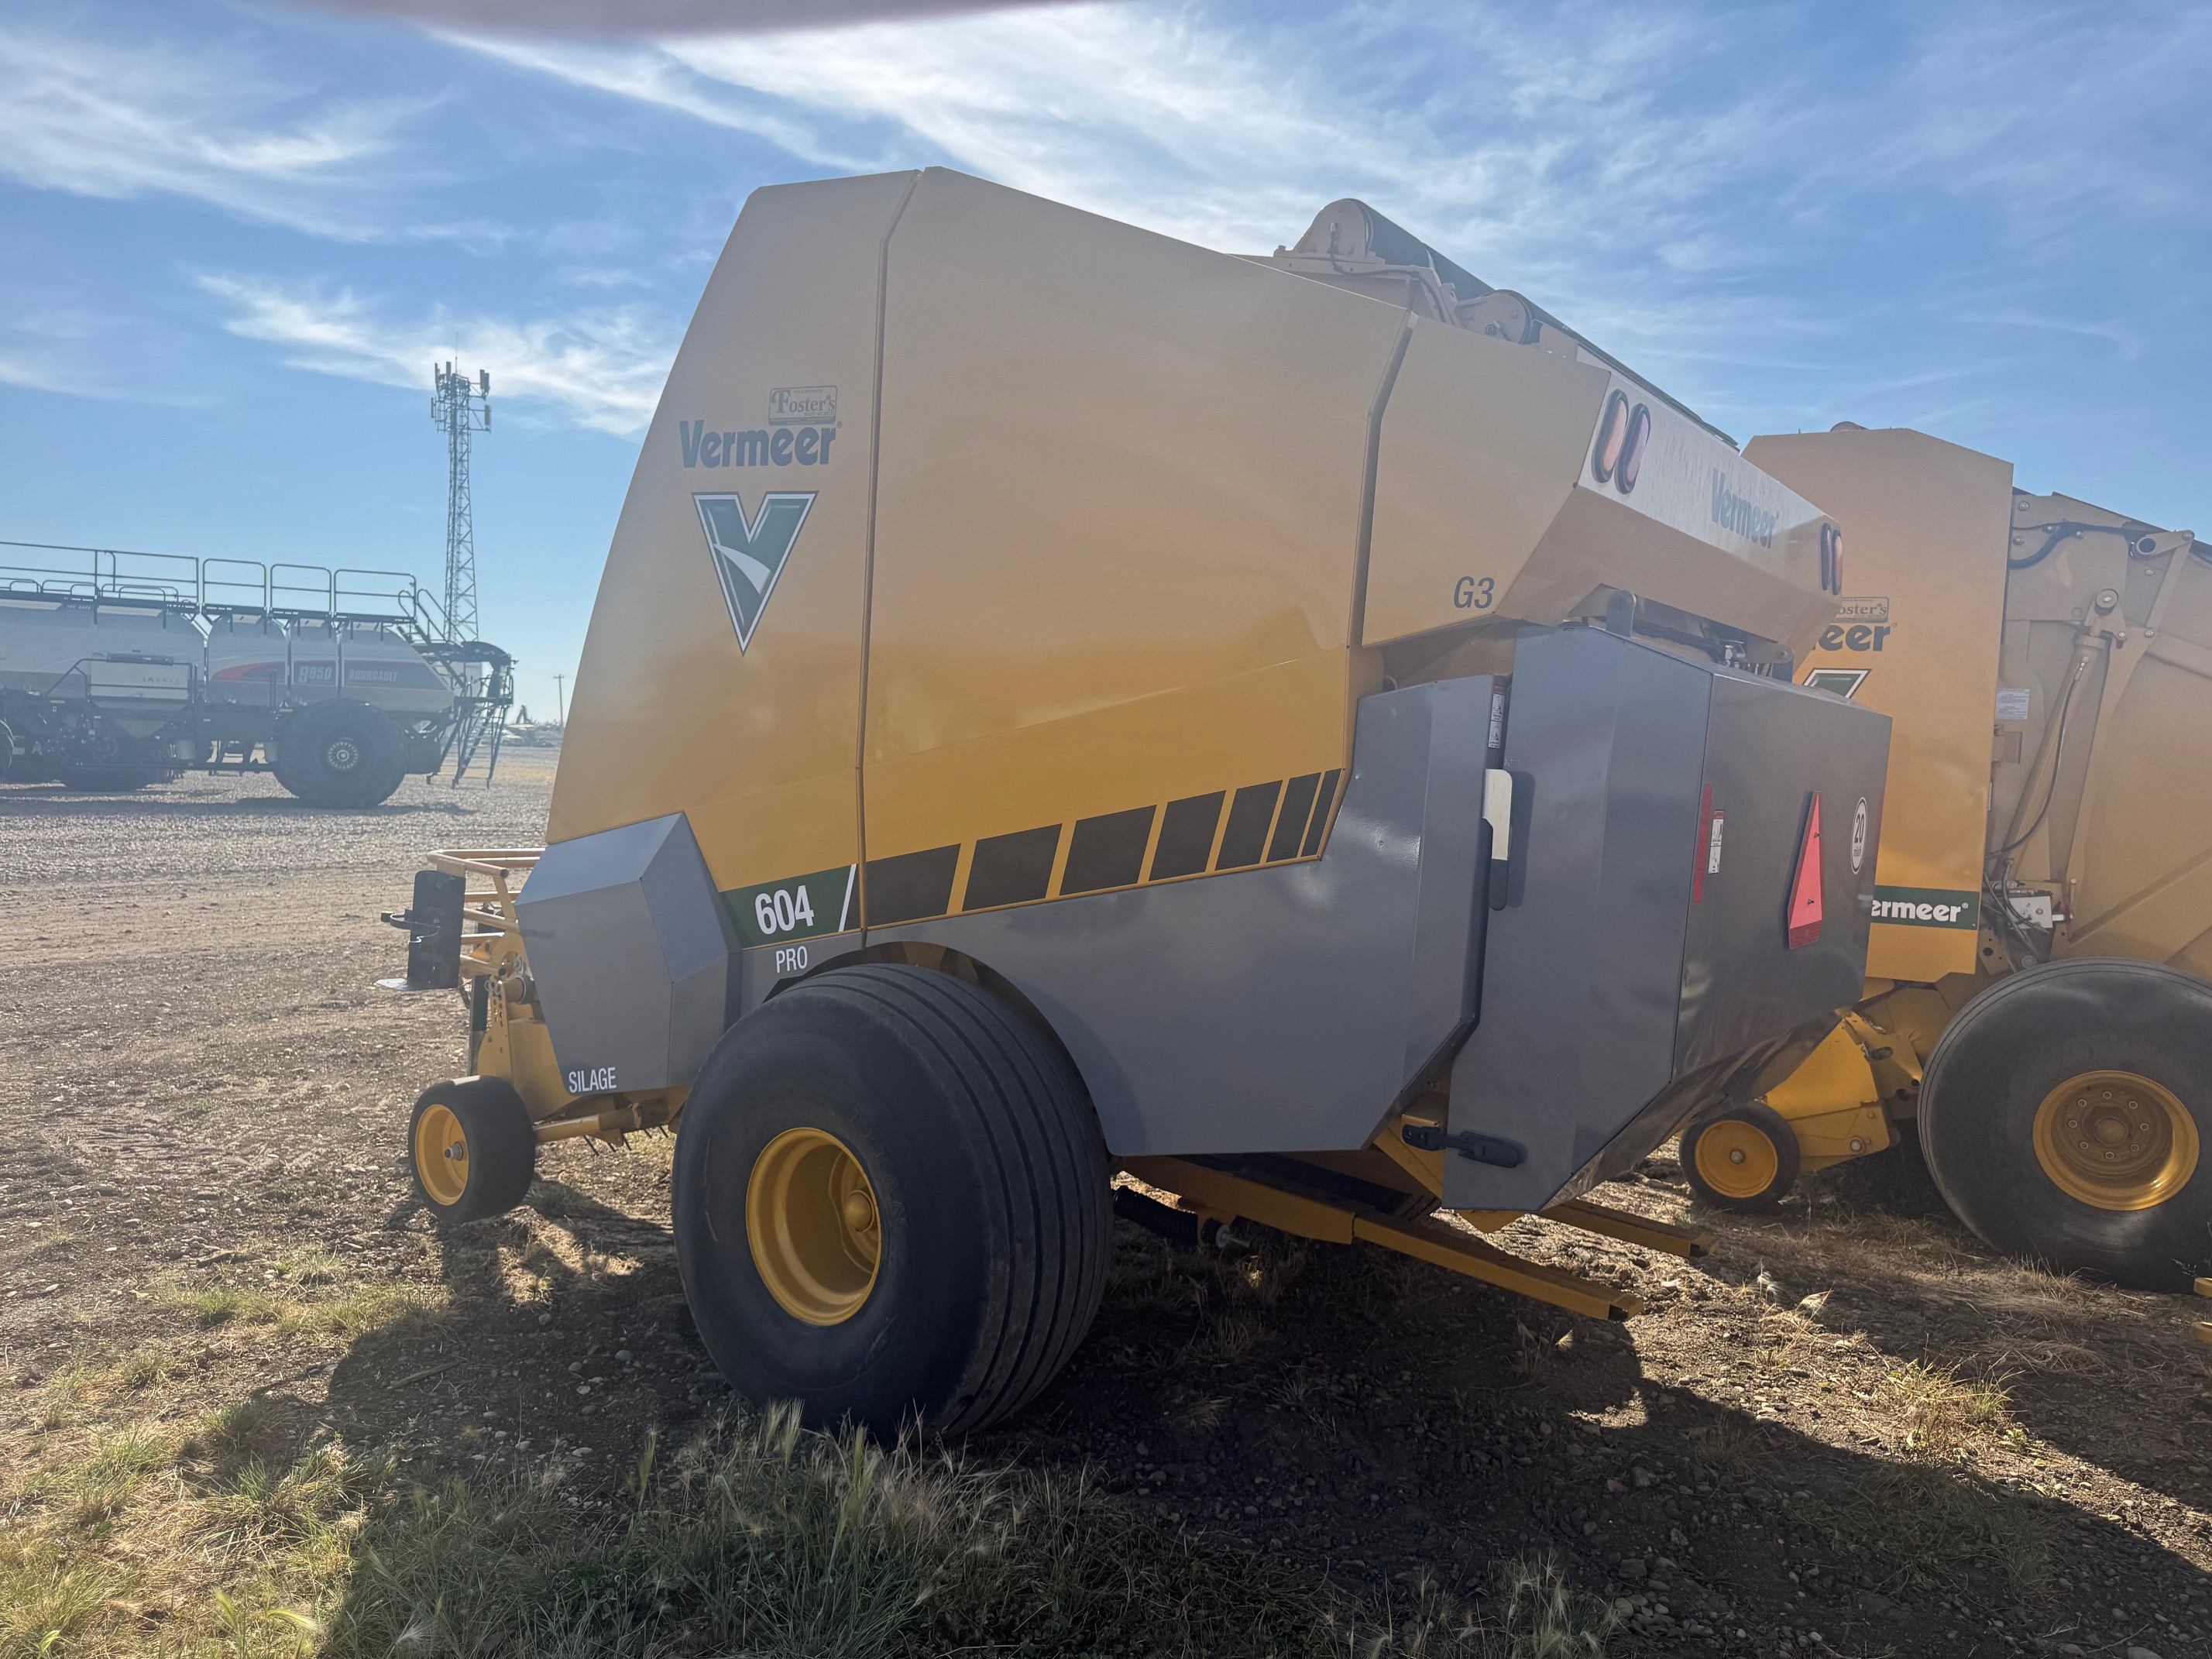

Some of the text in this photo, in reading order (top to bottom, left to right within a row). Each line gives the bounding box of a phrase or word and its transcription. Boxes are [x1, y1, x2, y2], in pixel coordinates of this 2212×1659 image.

[771, 389, 836, 414] Foster's
[679, 419, 836, 469] Vermeer
[1711, 467, 1776, 549] Vermeer
[1454, 576, 1495, 609] G3
[1838, 603, 1887, 616] oster's
[349, 669, 399, 682] BOURGAULT
[1854, 813, 1864, 843] 20
[755, 884, 814, 934] 604
[1871, 899, 1961, 922] ermeer
[776, 946, 808, 973] PRO
[568, 1066, 617, 1093] SILAGE
